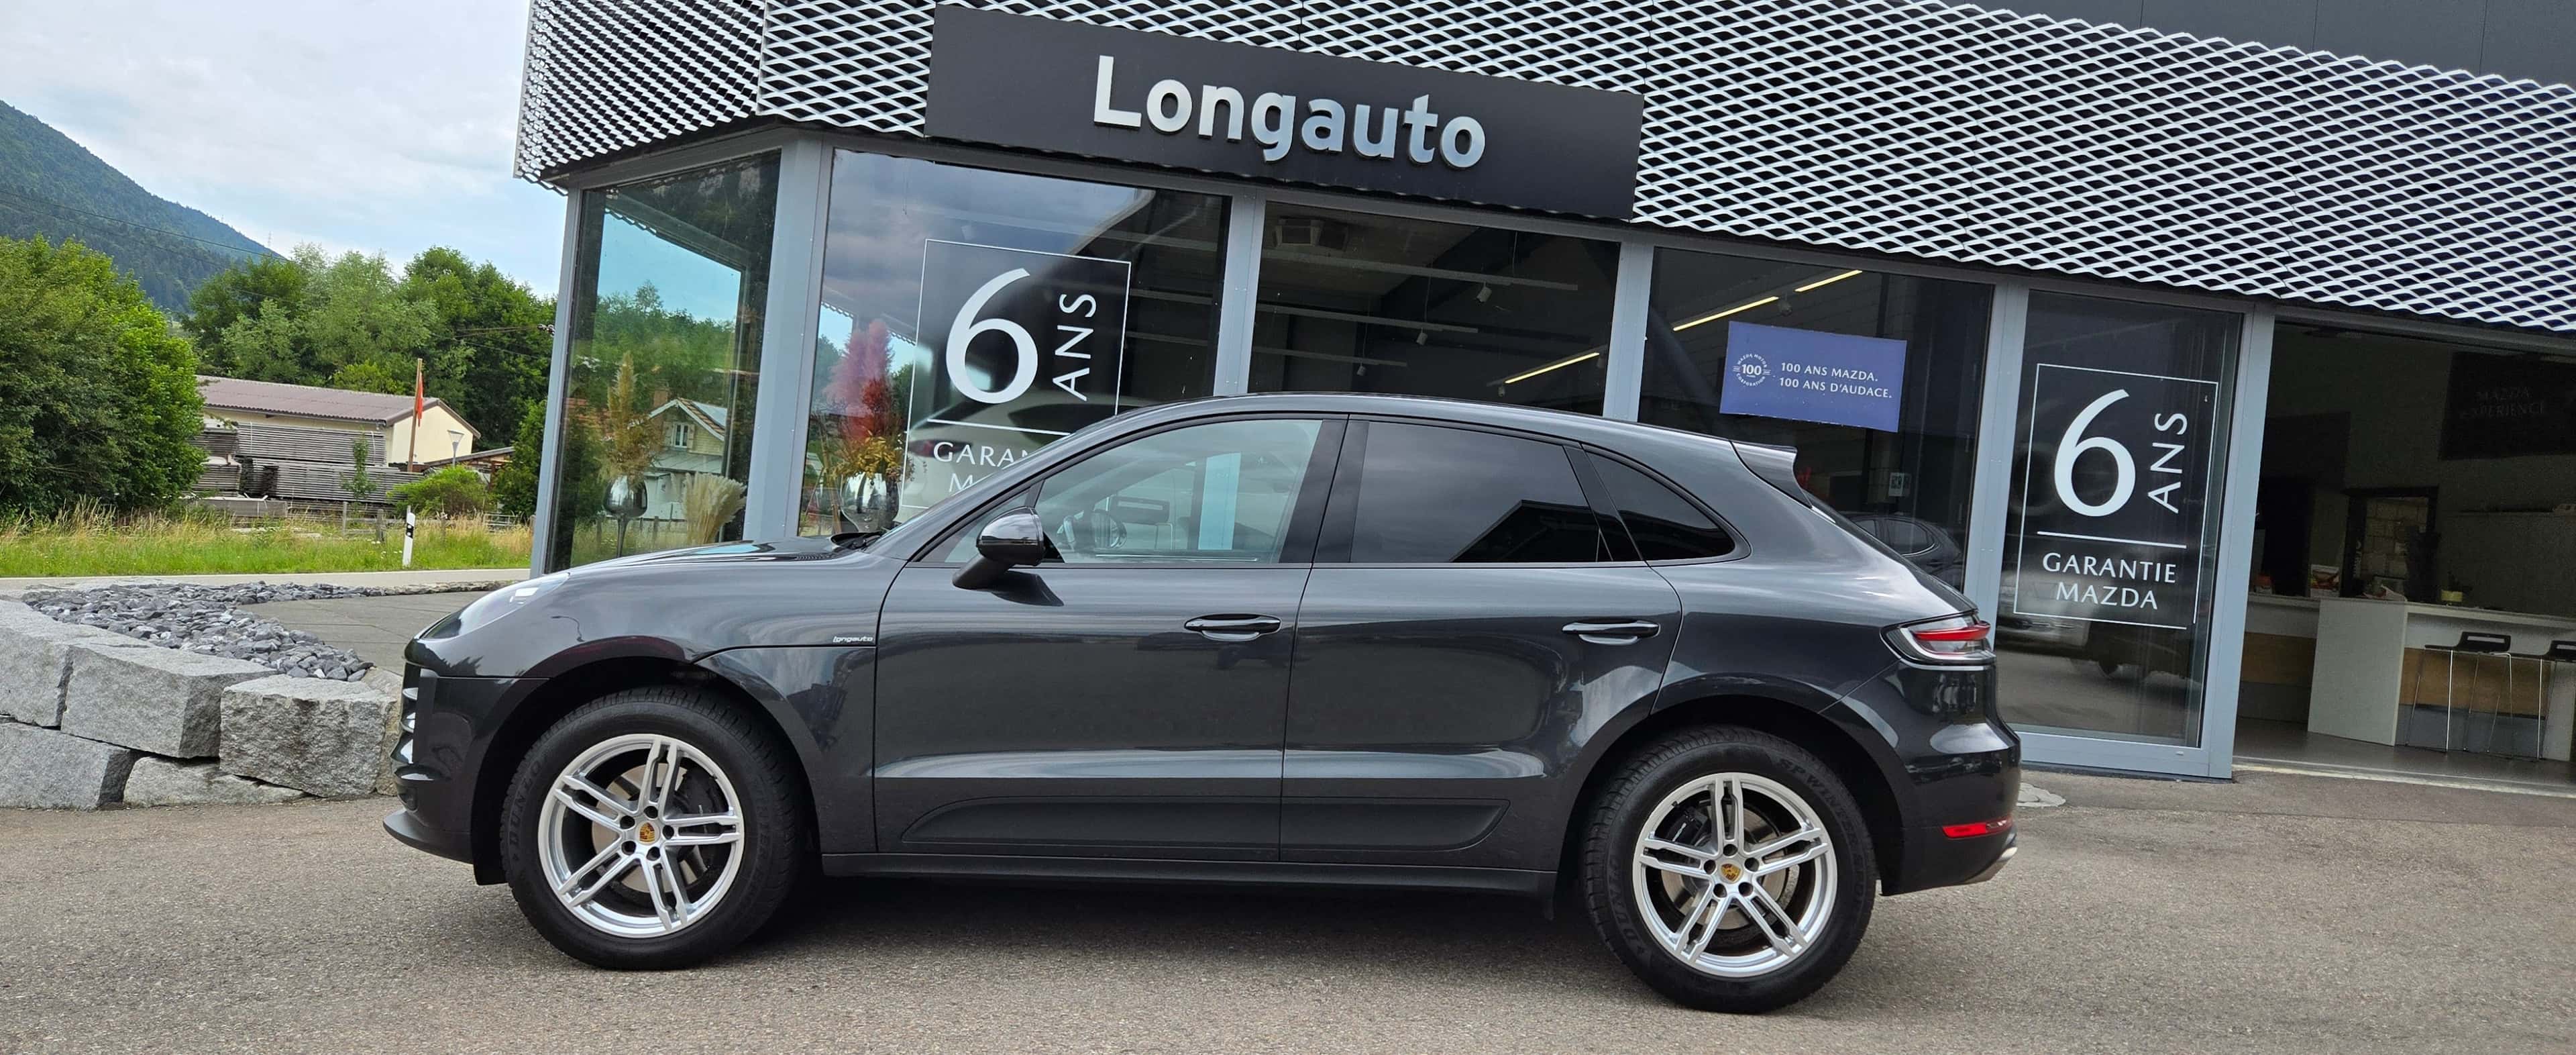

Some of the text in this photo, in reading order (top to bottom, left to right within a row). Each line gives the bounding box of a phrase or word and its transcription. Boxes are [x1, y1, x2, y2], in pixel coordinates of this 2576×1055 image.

[1093, 54, 1486, 170] Longauto
[946, 268, 1097, 404] 6 ANS
[1741, 364, 1762, 376] 100
[1782, 362, 1878, 382] 100 ANS MAZDA.
[1780, 377, 1892, 399] 100 ANS D'AUDACE.
[933, 442, 1028, 467] GARA
[2054, 389, 2188, 517] 6 ANS
[2043, 552, 2177, 584] GARANTIE
[2055, 582, 2158, 610] MAZDA
